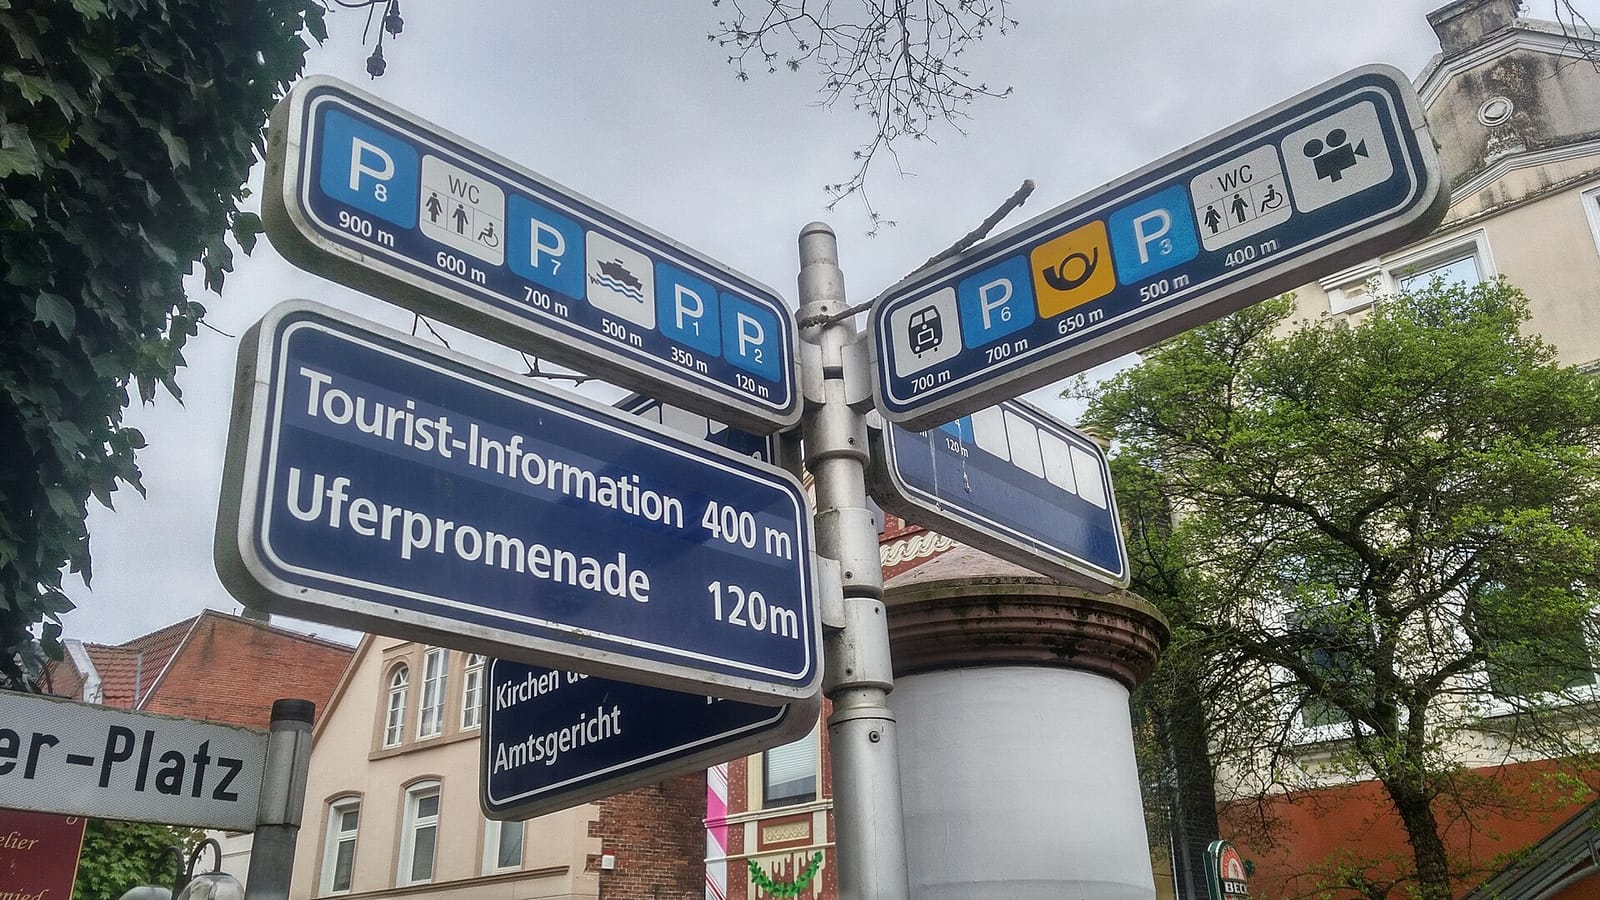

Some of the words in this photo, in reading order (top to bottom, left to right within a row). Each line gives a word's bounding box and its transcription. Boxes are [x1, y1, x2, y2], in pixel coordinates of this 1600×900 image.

[448, 174, 480, 204] WC
[1217, 164, 1253, 192] WC
[339, 210, 372, 237] 900
[377, 228, 394, 247] m
[436, 251, 466, 275] 600
[471, 267, 486, 284] m
[1224, 245, 1256, 268] 400
[1260, 238, 1278, 255] m
[523, 286, 550, 310] 700
[554, 301, 568, 317] m
[1140, 279, 1169, 303] 500
[1173, 274, 1190, 290] m
[602, 318, 626, 340] 500
[630, 332, 642, 347] m
[1058, 313, 1085, 335] 650
[1089, 308, 1104, 324] m
[671, 347, 693, 367] 350
[696, 360, 708, 374] m
[985, 342, 1011, 364] 700
[1014, 338, 1028, 352] m
[735, 373, 755, 392] 120
[758, 385, 769, 398] m
[911, 374, 934, 394] 700
[938, 369, 950, 383] m
[945, 437, 959, 454] 120
[300, 367, 684, 529] Tourist-Information
[702, 501, 757, 549] 400
[765, 526, 792, 560] m
[287, 467, 650, 603] Uferpromenade
[496, 669, 559, 711] Kirchen
[493, 704, 622, 775] Amtsgericht
